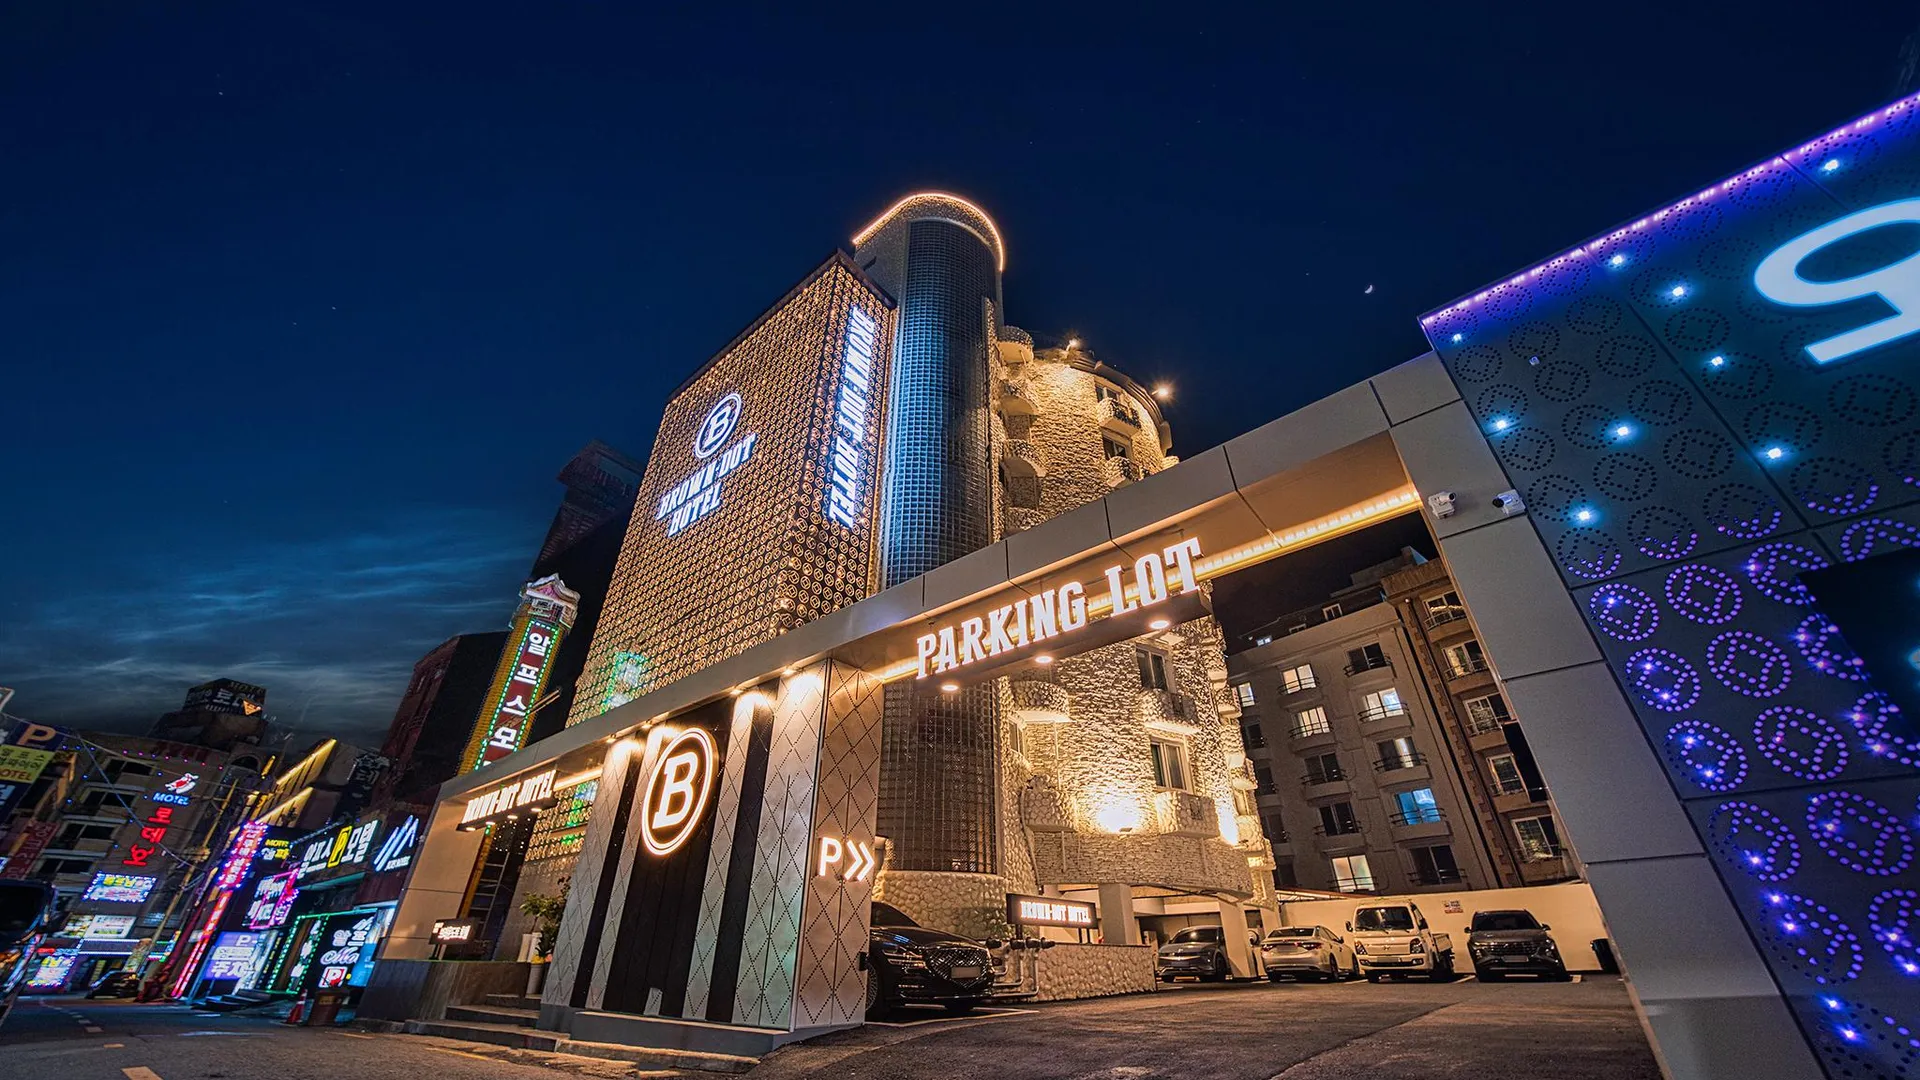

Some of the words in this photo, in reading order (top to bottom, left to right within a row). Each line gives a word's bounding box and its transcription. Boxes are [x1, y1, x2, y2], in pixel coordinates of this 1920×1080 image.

[828, 435, 860, 529] HOTEL
[668, 482, 724, 538] HOTEL
[916, 581, 1088, 680] PARKING
[1104, 537, 1202, 618] LOT
[483, 632, 550, 767] 알프스모
[17, 723, 56, 746] P
[0, 768, 32, 781] OTEL
[153, 792, 191, 806] MOTEL
[651, 751, 699, 830] B
[340, 819, 379, 864] 모텔
[819, 836, 843, 877] P
